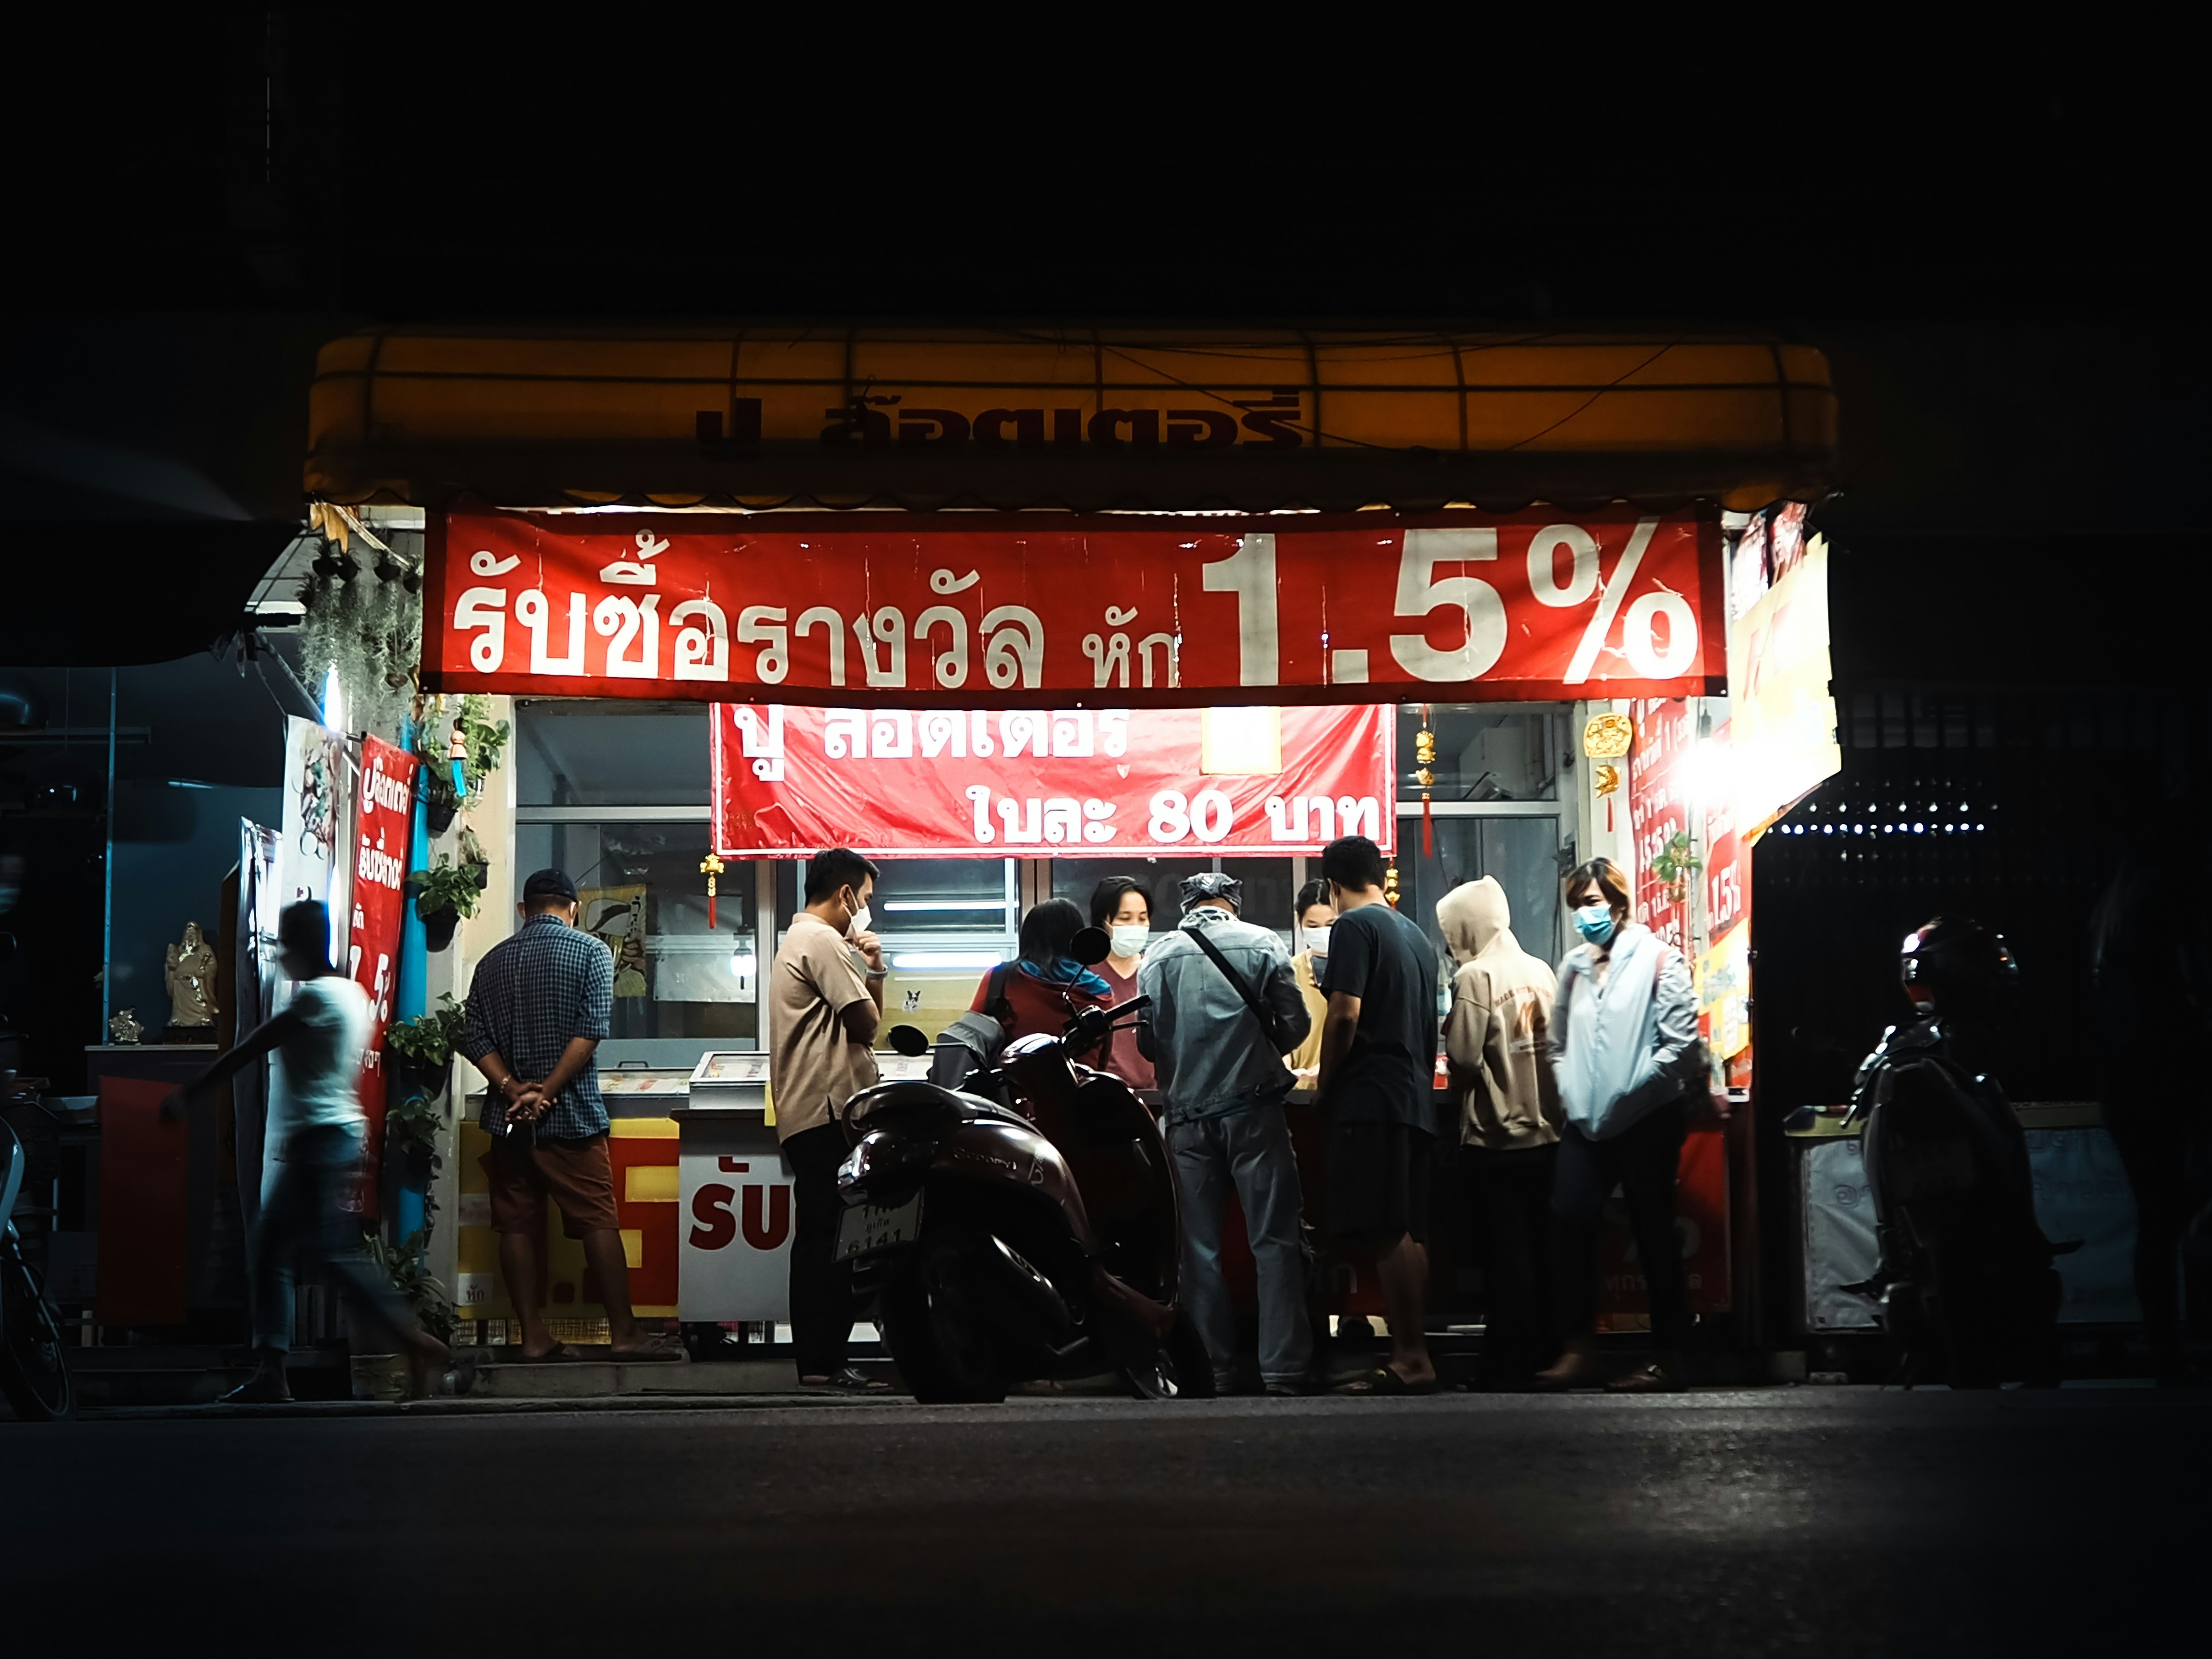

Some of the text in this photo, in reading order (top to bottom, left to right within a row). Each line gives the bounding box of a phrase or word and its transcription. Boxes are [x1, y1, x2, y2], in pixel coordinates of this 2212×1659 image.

[453, 529, 1044, 689] รับซื้อรางวัล
[1082, 605, 1179, 688] หัก
[1202, 516, 1698, 686] 1.5%
[734, 704, 784, 781] ปู
[965, 785, 1380, 843] ใบละ 80 บาท
[688, 1156, 790, 1250] รับ
[847, 1228, 901, 1253] 6141
